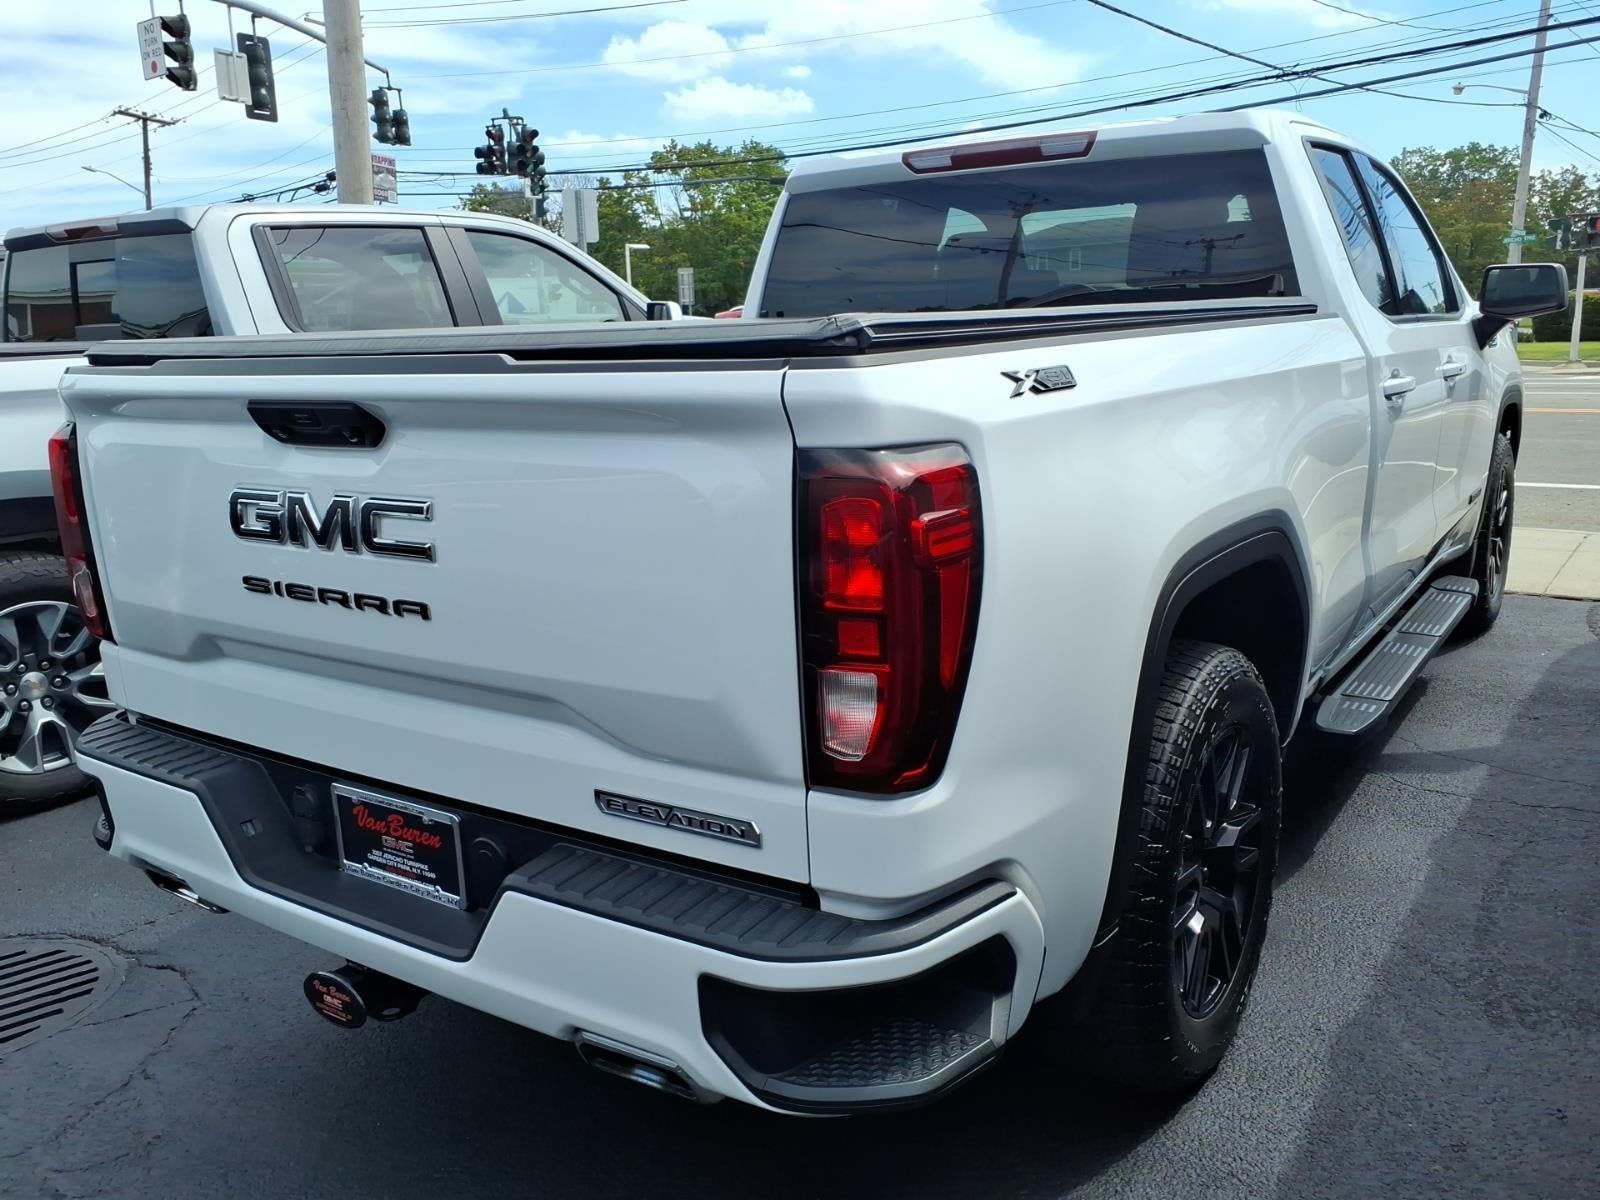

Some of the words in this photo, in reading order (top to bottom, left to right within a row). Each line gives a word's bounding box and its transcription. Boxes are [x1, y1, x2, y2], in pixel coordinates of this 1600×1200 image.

[144, 23, 154, 36] NO
[152, 47, 162, 57] RED
[229, 487, 436, 563] GMC
[242, 575, 432, 621] SIERRA
[353, 805, 387, 832] Van
[387, 814, 442, 848] Buren
[607, 799, 746, 838] ELEVATION
[382, 836, 414, 854] GMC
